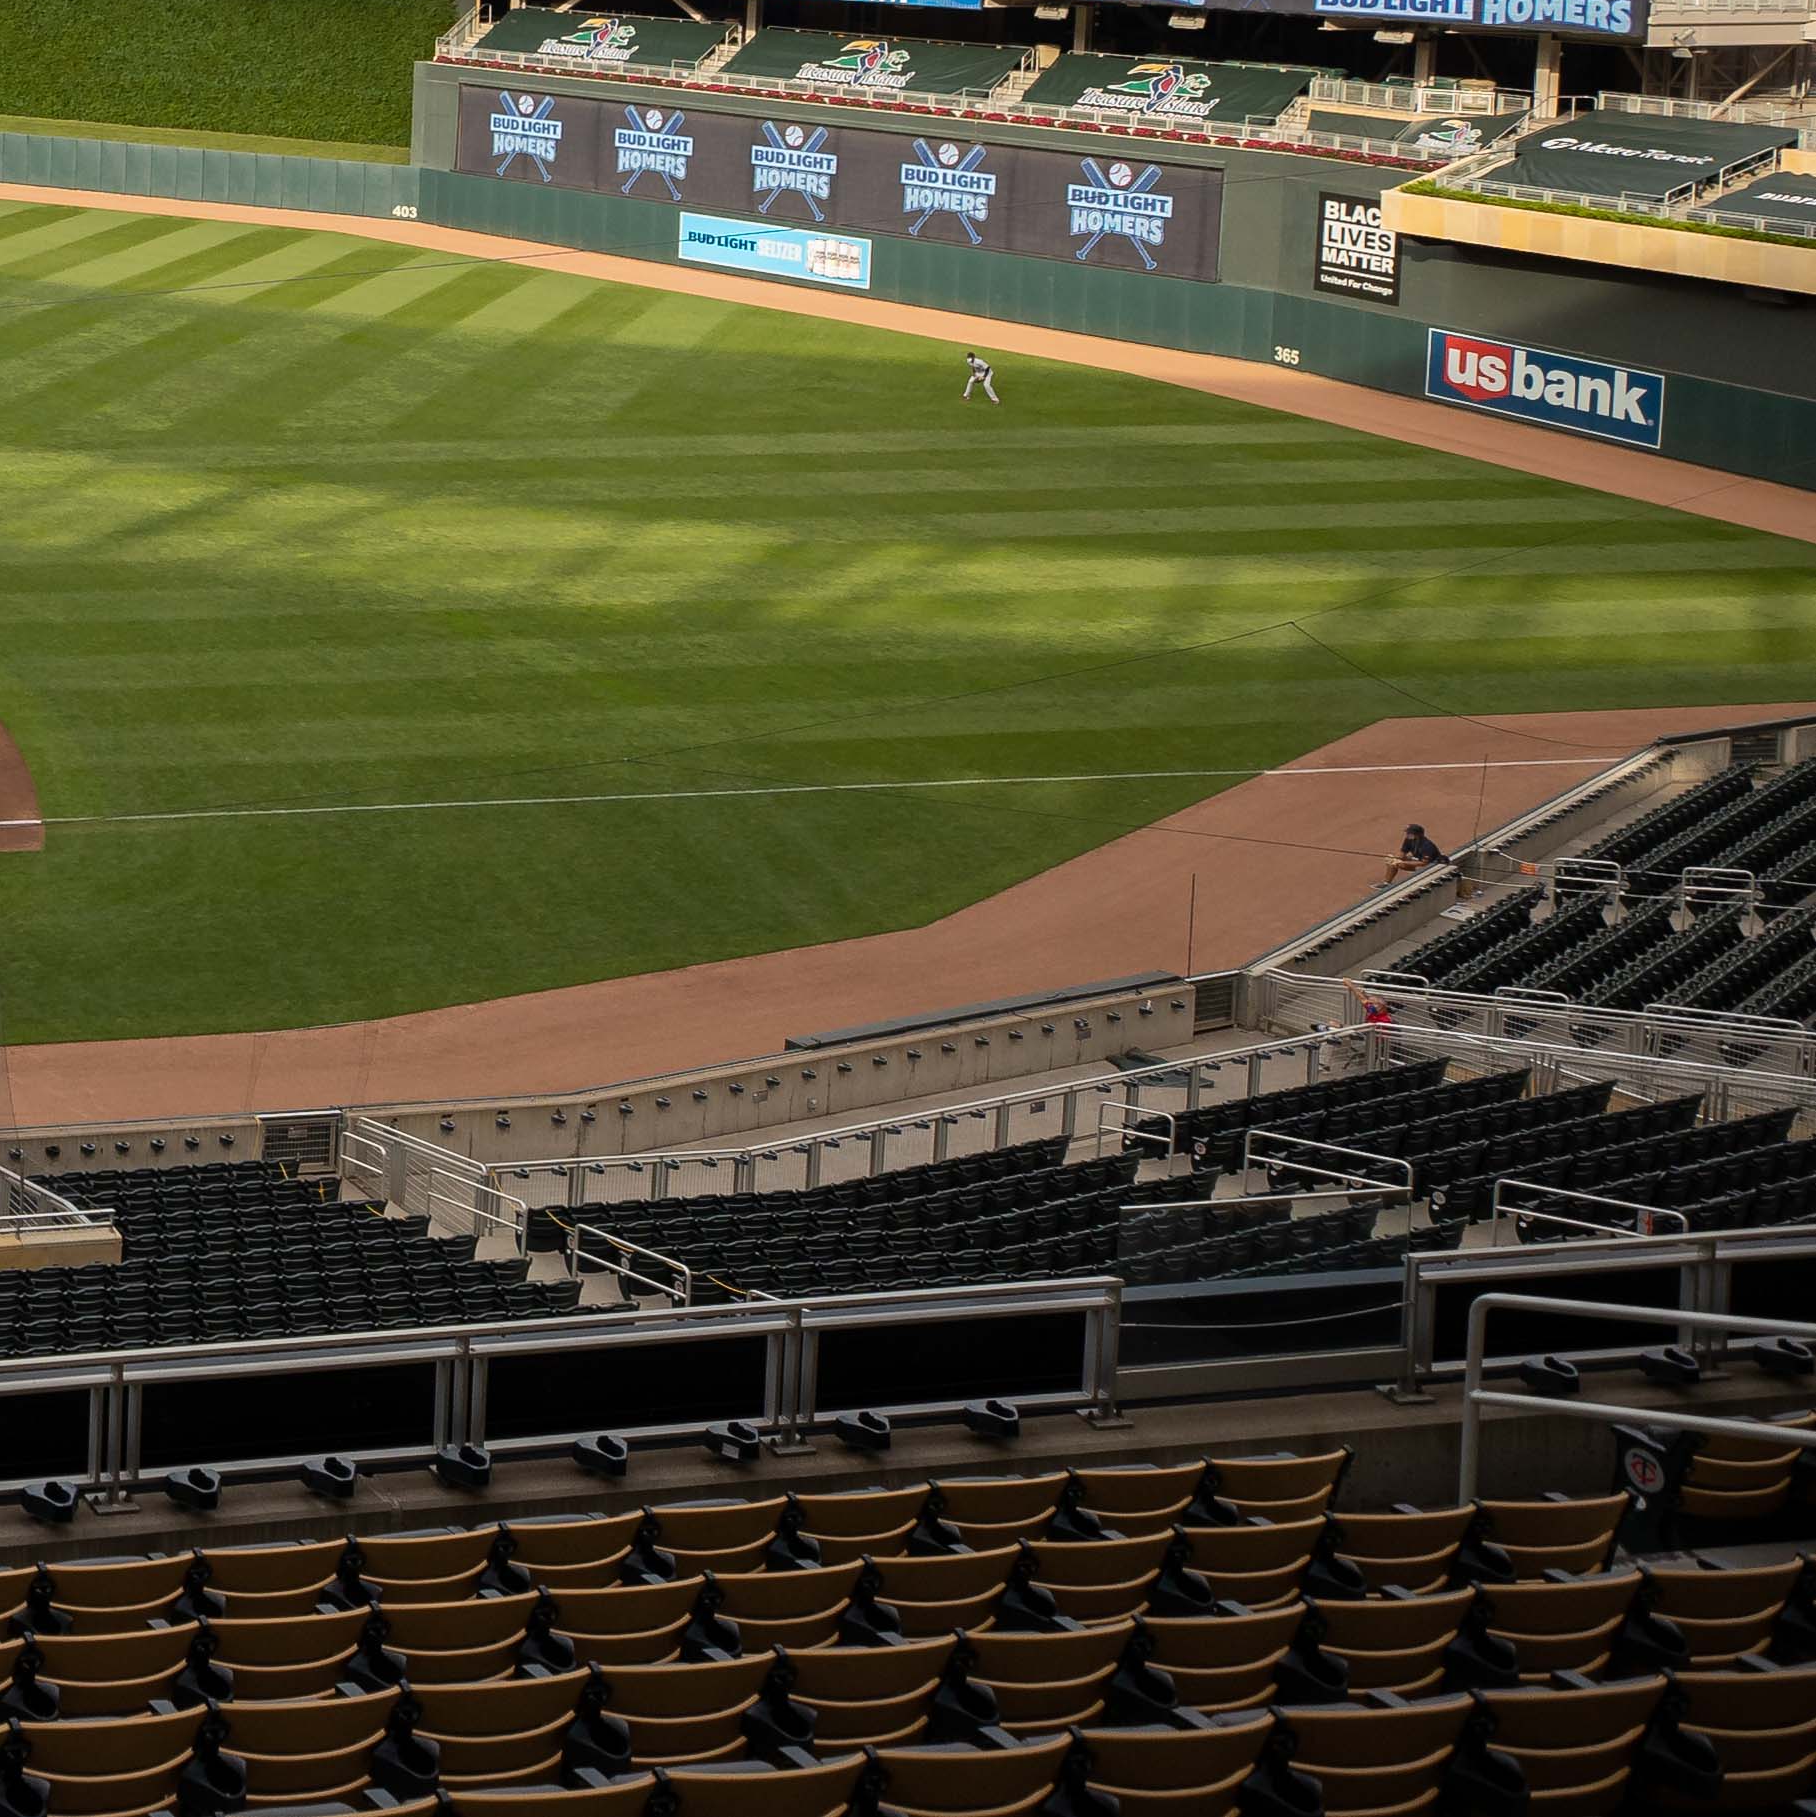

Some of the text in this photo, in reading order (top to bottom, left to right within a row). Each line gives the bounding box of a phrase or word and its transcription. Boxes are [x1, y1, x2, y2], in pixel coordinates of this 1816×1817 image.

[754, 148, 834, 171] BUD LIGHT
[753, 167, 829, 198] HOMERS
[392, 204, 418, 219] 403
[688, 231, 757, 251] BUD LIGHT
[1327, 224, 1393, 253] LIVES
[1322, 247, 1393, 275] MATTER
[1273, 346, 1300, 366] 365
